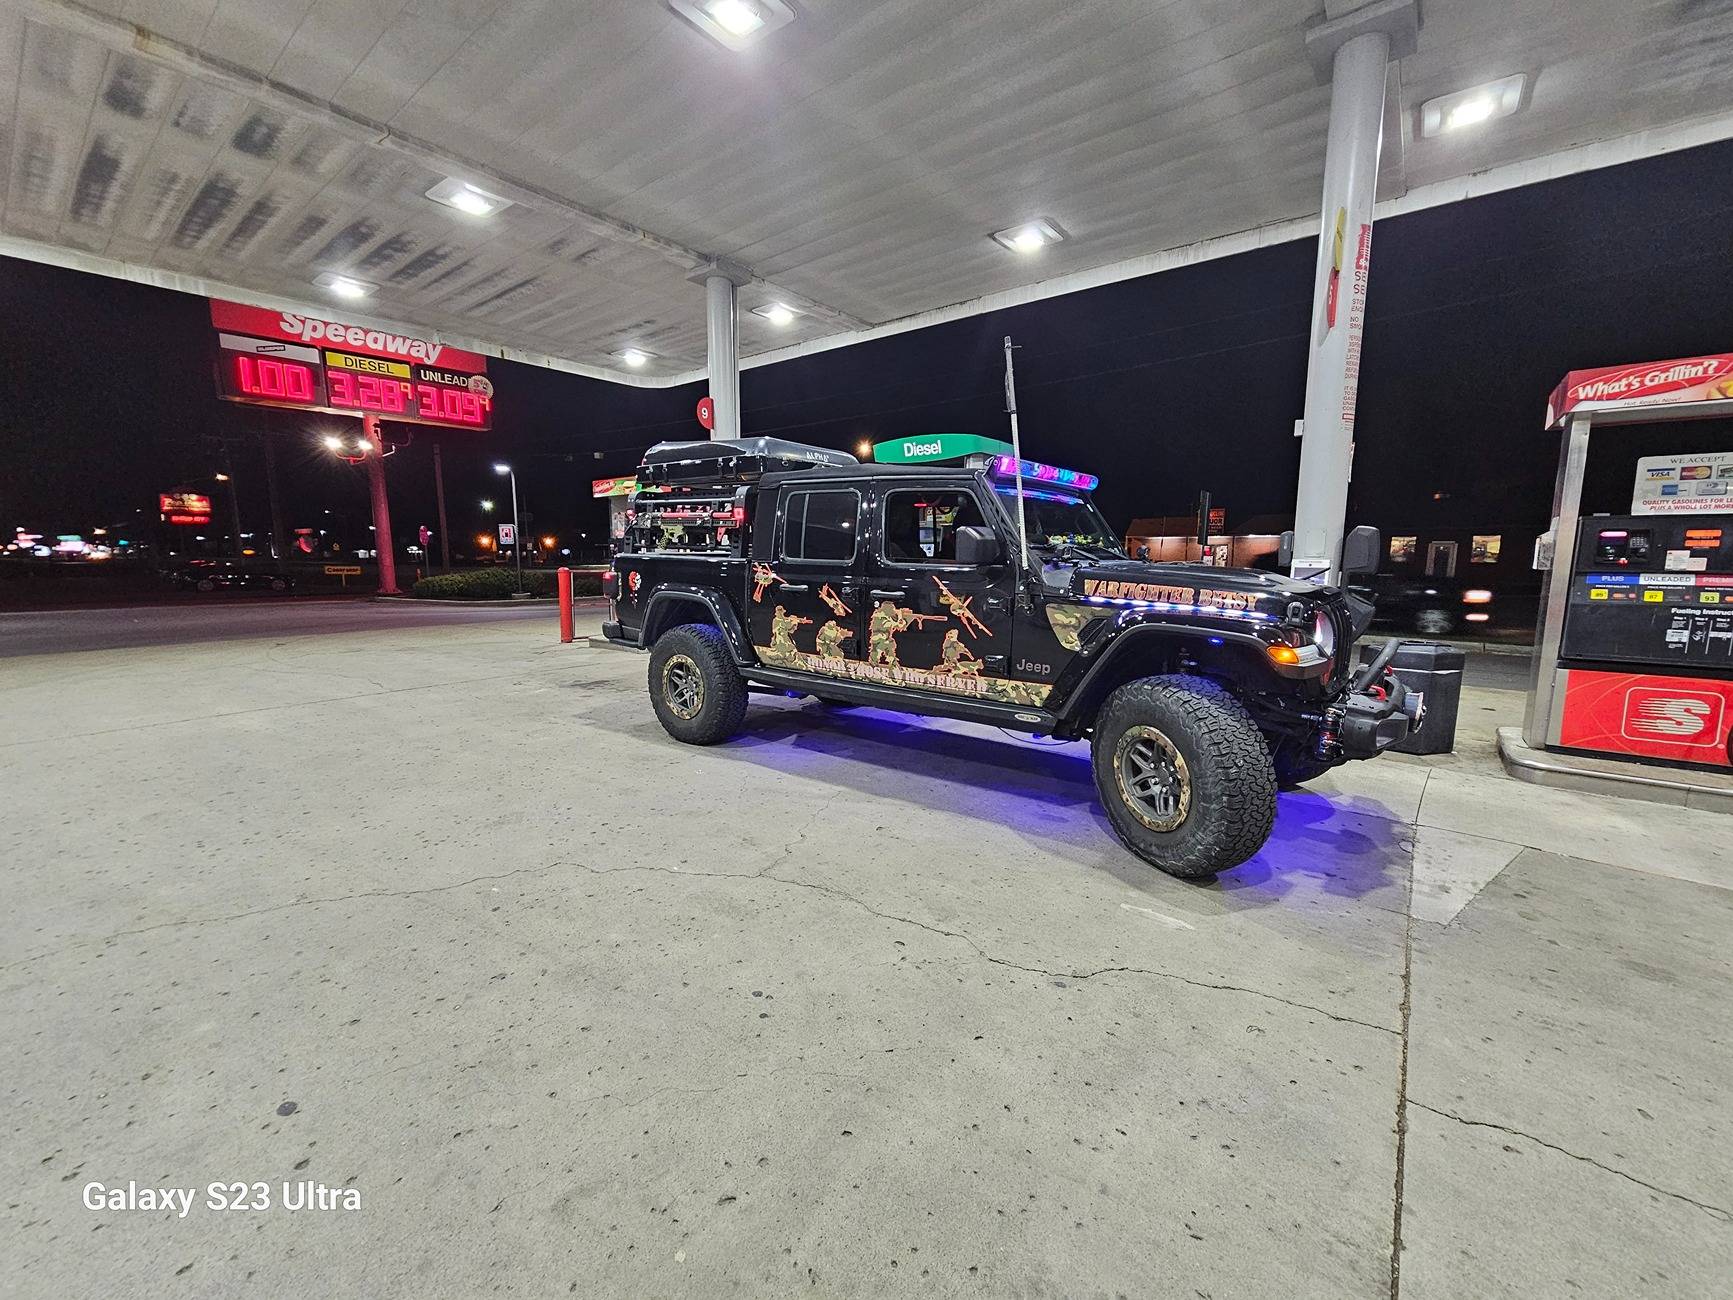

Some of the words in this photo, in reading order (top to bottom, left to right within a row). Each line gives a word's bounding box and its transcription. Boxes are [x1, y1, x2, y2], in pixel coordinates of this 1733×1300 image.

[279, 311, 443, 364] Speedway
[344, 357, 394, 374] DIESEL
[420, 369, 468, 387] UNLEAD
[1577, 376, 1641, 400] What's
[1644, 360, 1719, 385] Grillin'?
[701, 407, 709, 419] 9
[903, 440, 942, 457] Diesel
[1687, 455, 1727, 464] ACCEPT
[1084, 579, 1194, 605] WARFIGHTER
[1199, 589, 1259, 611] BETSY
[1671, 607, 1701, 616] Fueling
[1016, 658, 1051, 675] Jeep
